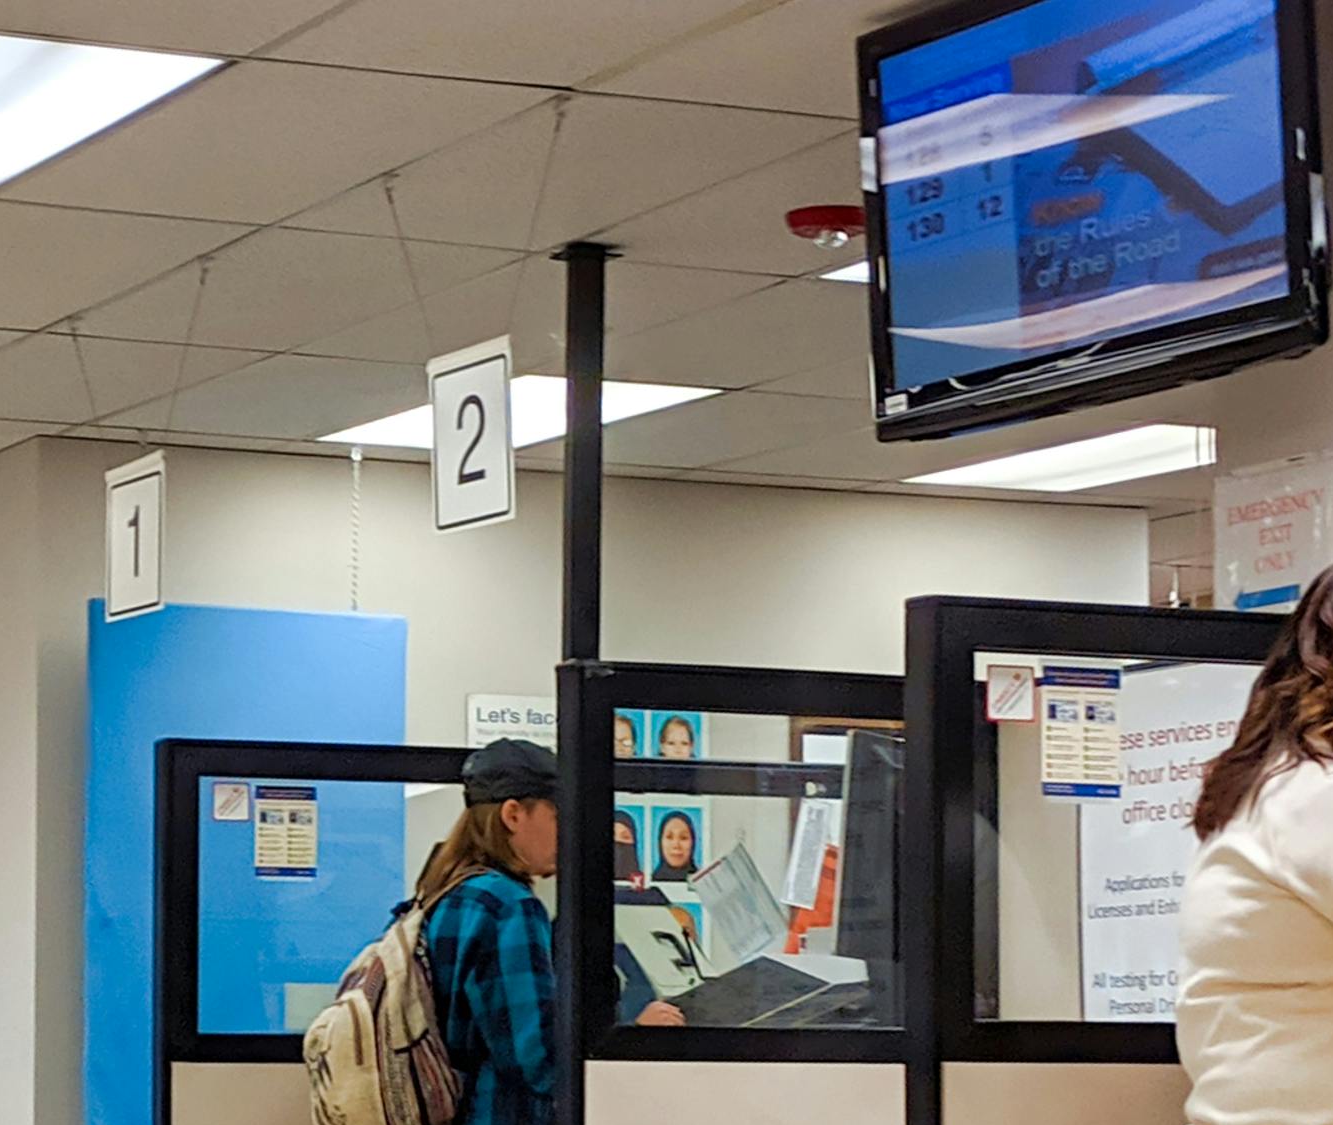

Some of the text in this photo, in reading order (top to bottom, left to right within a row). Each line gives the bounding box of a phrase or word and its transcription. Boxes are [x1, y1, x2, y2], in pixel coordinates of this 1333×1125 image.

[907, 177, 943, 205] 129
[907, 195, 1003, 241] 130 12
[1080, 209, 1151, 242] Rules
[1035, 260, 1062, 288] of
[1115, 231, 1182, 265] Road
[456, 394, 486, 486] 2
[127, 505, 140, 578] 1
[476, 707, 555, 725] Let's fac
[1119, 720, 1237, 750] ese services en
[1128, 757, 1205, 786] hour befo
[1123, 796, 1194, 825] office clo
[1105, 874, 1169, 894] Applications
[1088, 903, 1133, 920] Licenses
[1135, 899, 1155, 916] and
[1109, 972, 1147, 991] testing
[1149, 969, 1165, 987] for
[1108, 997, 1155, 1015] Personal
